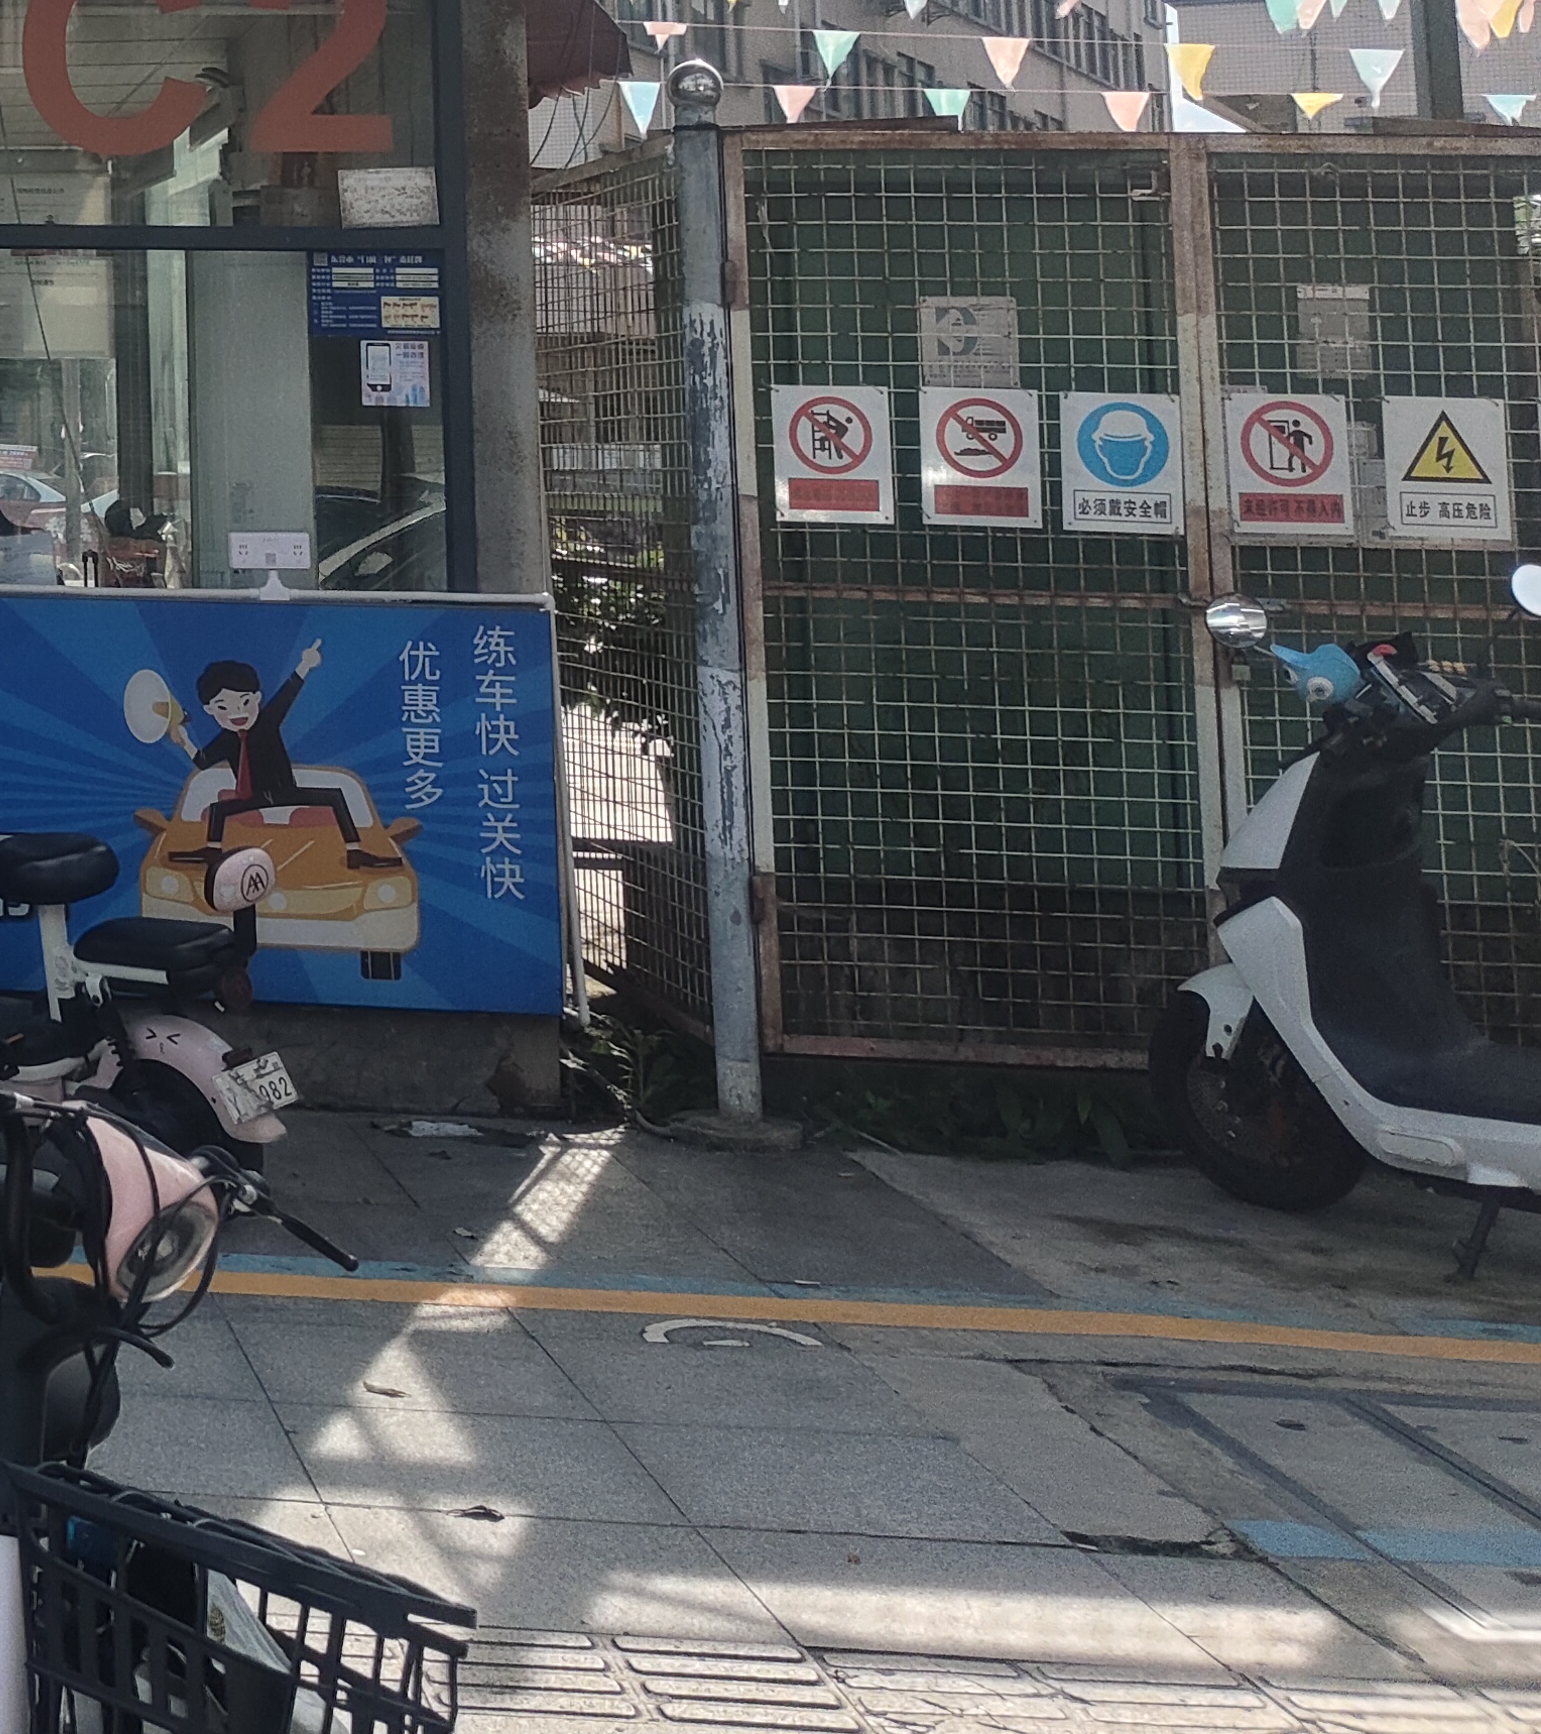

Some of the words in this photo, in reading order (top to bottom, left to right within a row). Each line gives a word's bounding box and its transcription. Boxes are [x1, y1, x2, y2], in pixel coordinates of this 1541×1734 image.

[1076, 498, 1169, 521] 必须戴安全帽
[1404, 500, 1431, 518] 止步
[1438, 501, 1493, 522] 高压危险
[398, 639, 444, 812] 优惠更多
[473, 624, 519, 757] 练车快
[476, 768, 526, 901] 过关快
